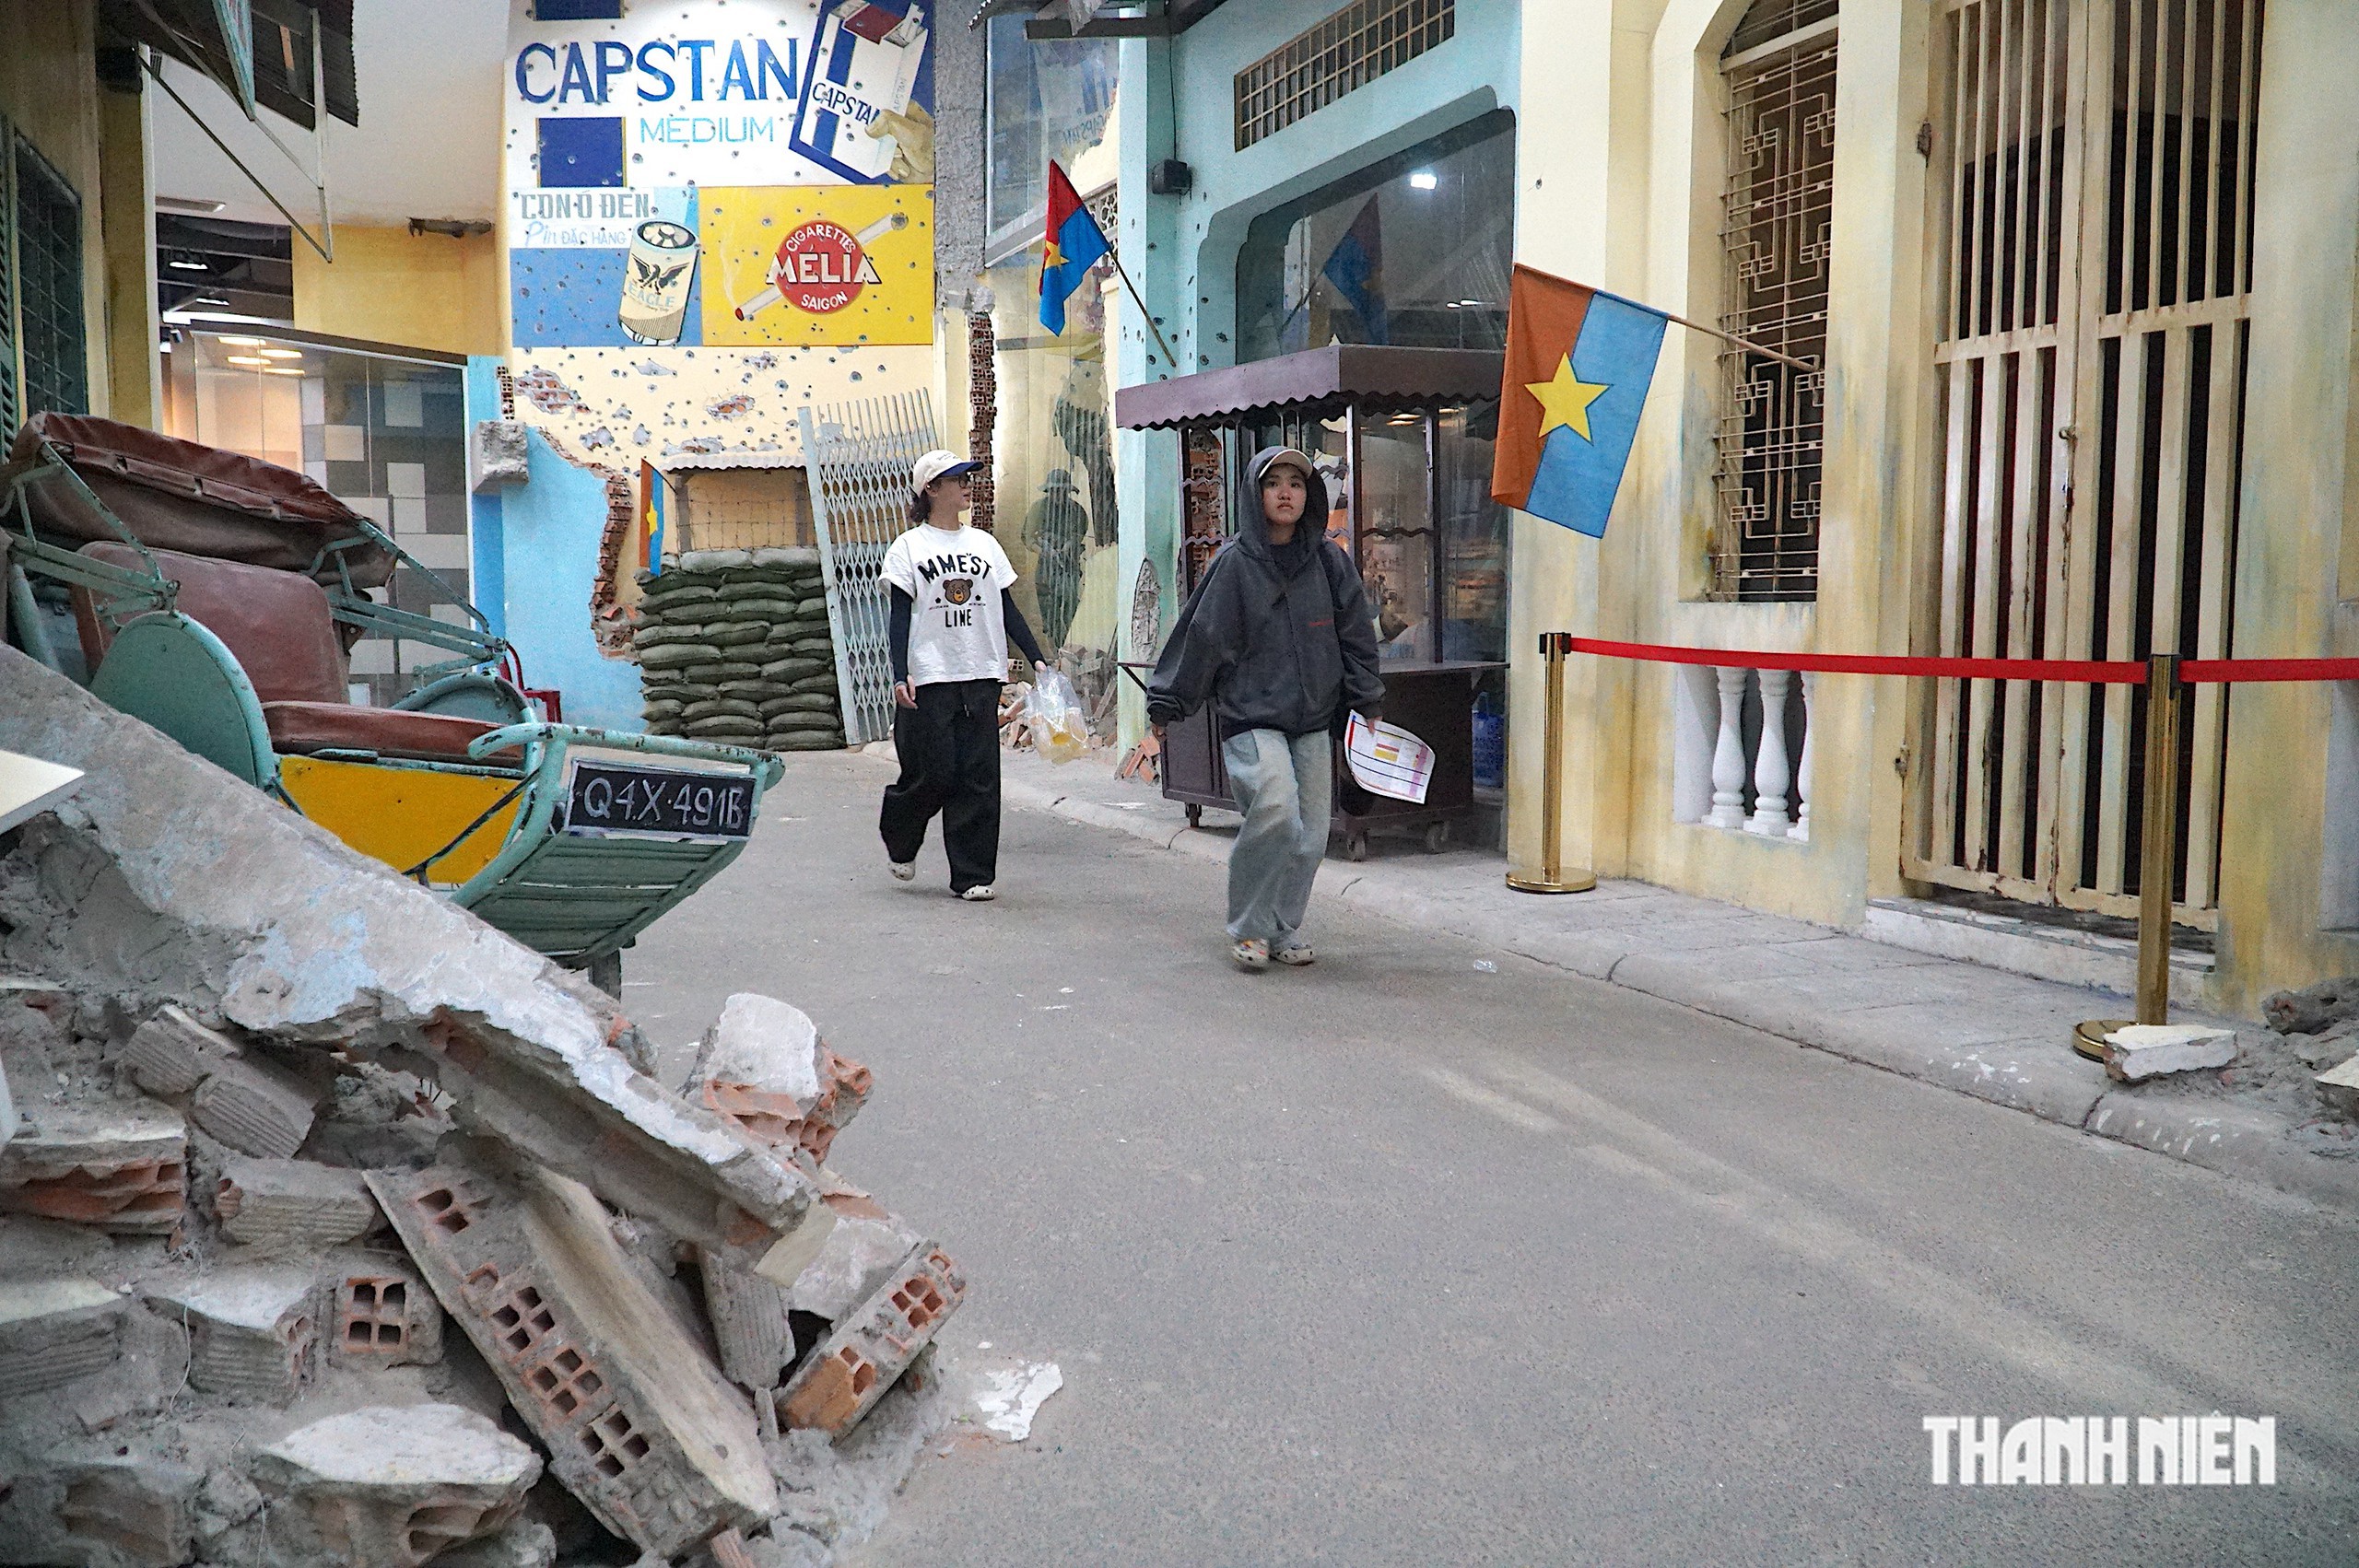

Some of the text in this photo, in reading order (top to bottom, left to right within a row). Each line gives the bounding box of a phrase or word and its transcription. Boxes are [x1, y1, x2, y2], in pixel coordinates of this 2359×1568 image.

[515, 38, 798, 104] CAPSTAN
[640, 116, 773, 143] MEDIUM
[521, 193, 570, 219] CON
[599, 193, 650, 218] ĐEN
[524, 220, 557, 248] Pin
[785, 224, 856, 253] CIGARETTES
[766, 244, 883, 285] MÉLIA
[801, 290, 848, 310] SAIGON
[945, 609, 972, 627] LINE
